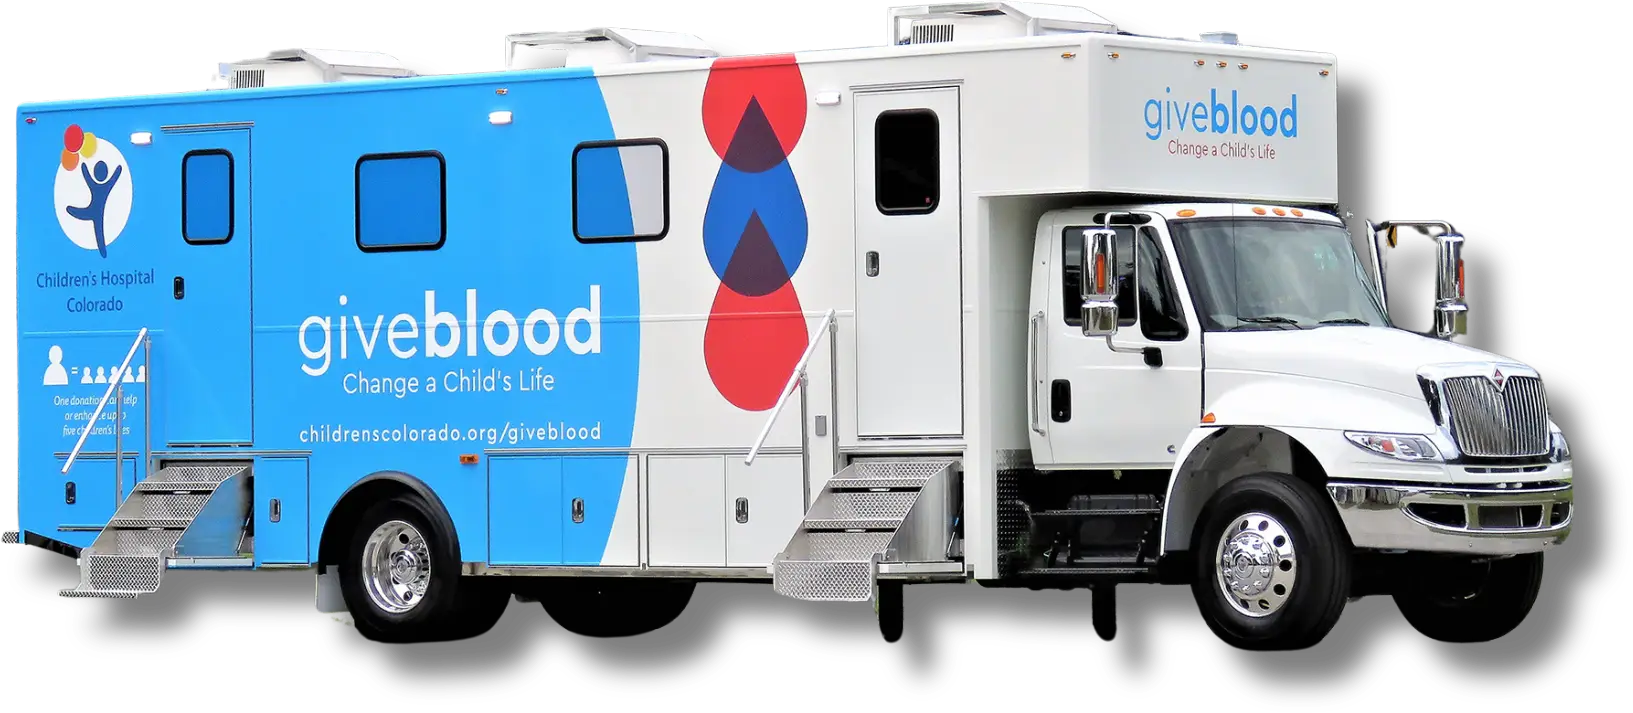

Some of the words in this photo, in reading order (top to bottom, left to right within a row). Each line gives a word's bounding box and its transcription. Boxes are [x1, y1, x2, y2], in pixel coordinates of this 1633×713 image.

[1168, 139, 1208, 158] Change
[1211, 145, 1218, 156] a
[1220, 142, 1255, 158] Child's
[1258, 144, 1276, 159] Life
[36, 271, 97, 288] Children's
[101, 268, 154, 289] Hospital
[66, 296, 123, 313] Colorado
[343, 370, 419, 399] Change
[425, 376, 436, 392] a
[443, 368, 512, 392] Child's
[519, 367, 555, 391] Life
[54, 395, 69, 406] One
[64, 412, 73, 421] or
[63, 425, 76, 437] five
[299, 422, 601, 444] childrenscolorado.org/giveblood
